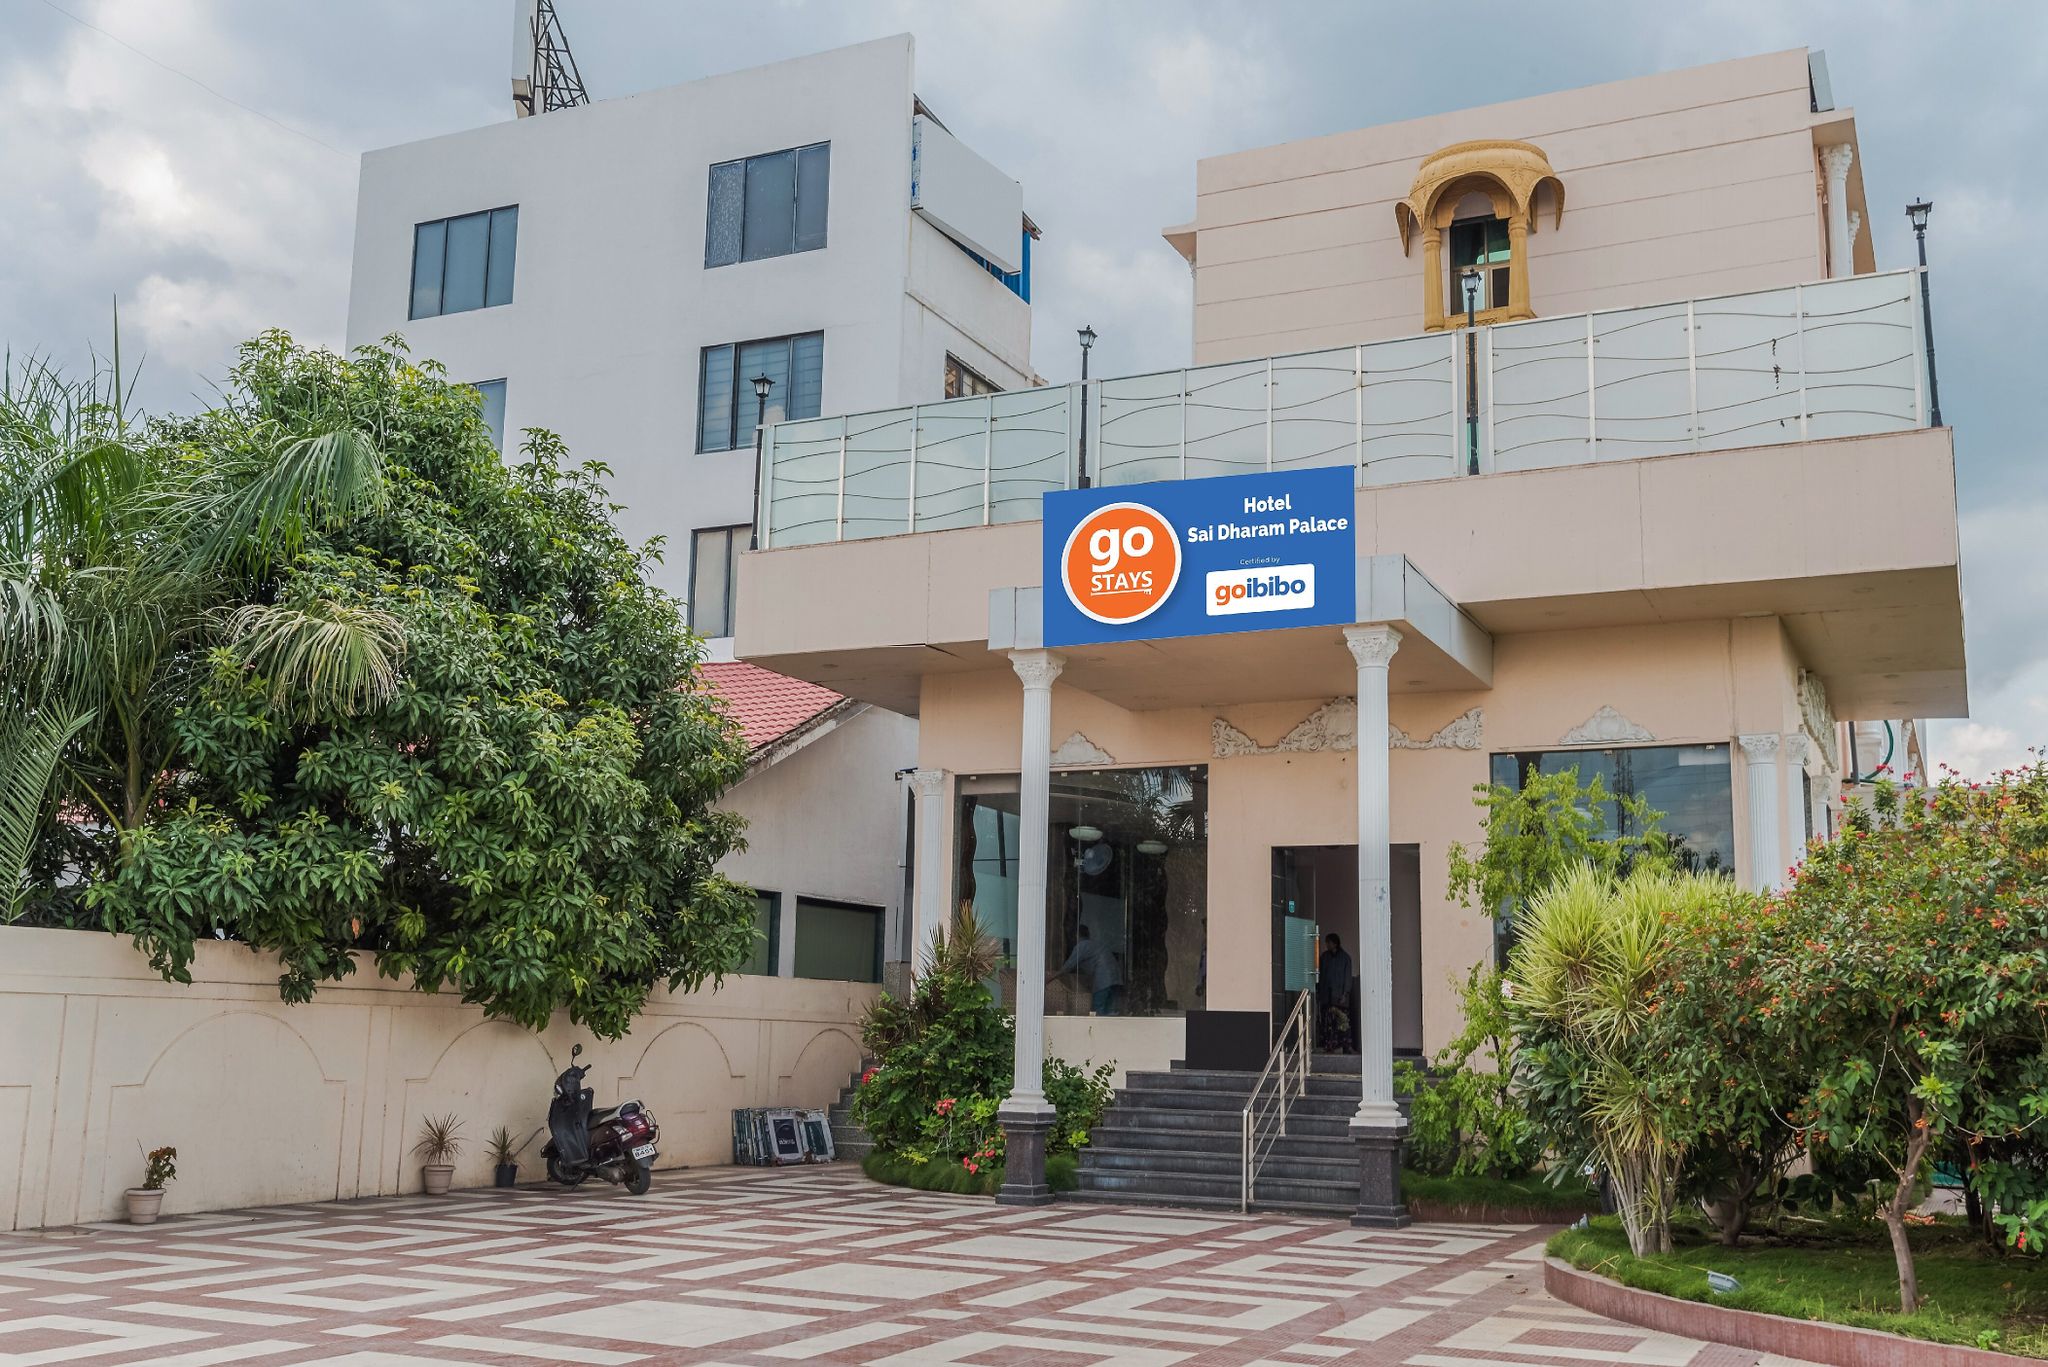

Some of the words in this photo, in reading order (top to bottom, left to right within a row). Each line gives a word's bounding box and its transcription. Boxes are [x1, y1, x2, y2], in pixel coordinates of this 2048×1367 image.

[1244, 494, 1292, 513] Hotel
[1188, 525, 1213, 542] Sai
[1218, 523, 1285, 541] Dharam
[1289, 516, 1348, 535] Palace
[1089, 525, 1154, 573] go
[1240, 557, 1270, 565] Certified
[1271, 557, 1281, 565] by
[1091, 570, 1153, 592] STAYS
[1215, 575, 1306, 606] goibibo
